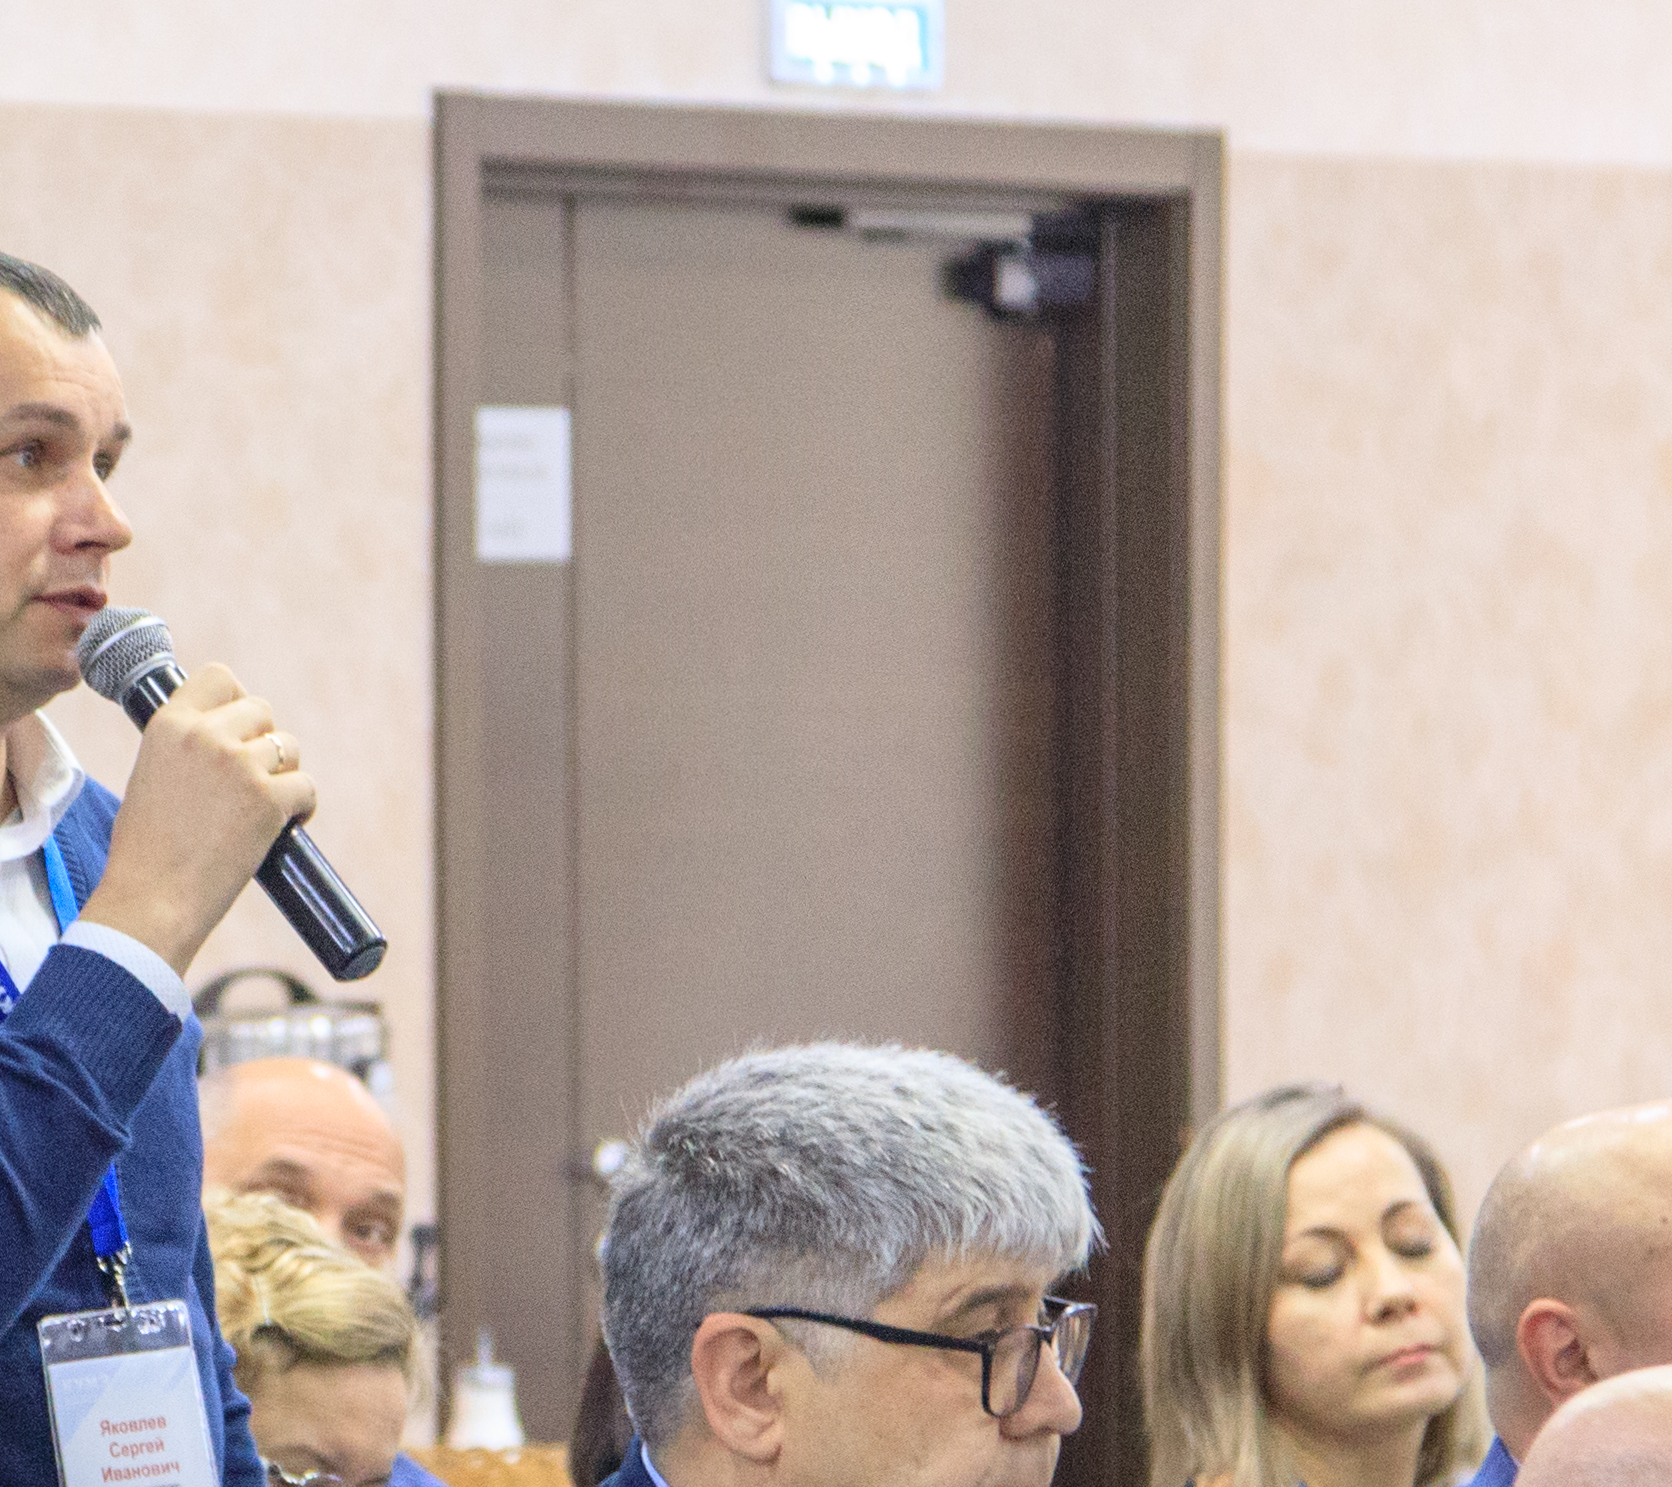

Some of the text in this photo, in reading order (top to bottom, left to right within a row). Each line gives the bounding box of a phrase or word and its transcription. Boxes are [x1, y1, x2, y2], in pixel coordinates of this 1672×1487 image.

[99, 1415, 167, 1436] Яковлев
[108, 1437, 166, 1460] Сергей
[101, 1461, 181, 1483] Иванович
